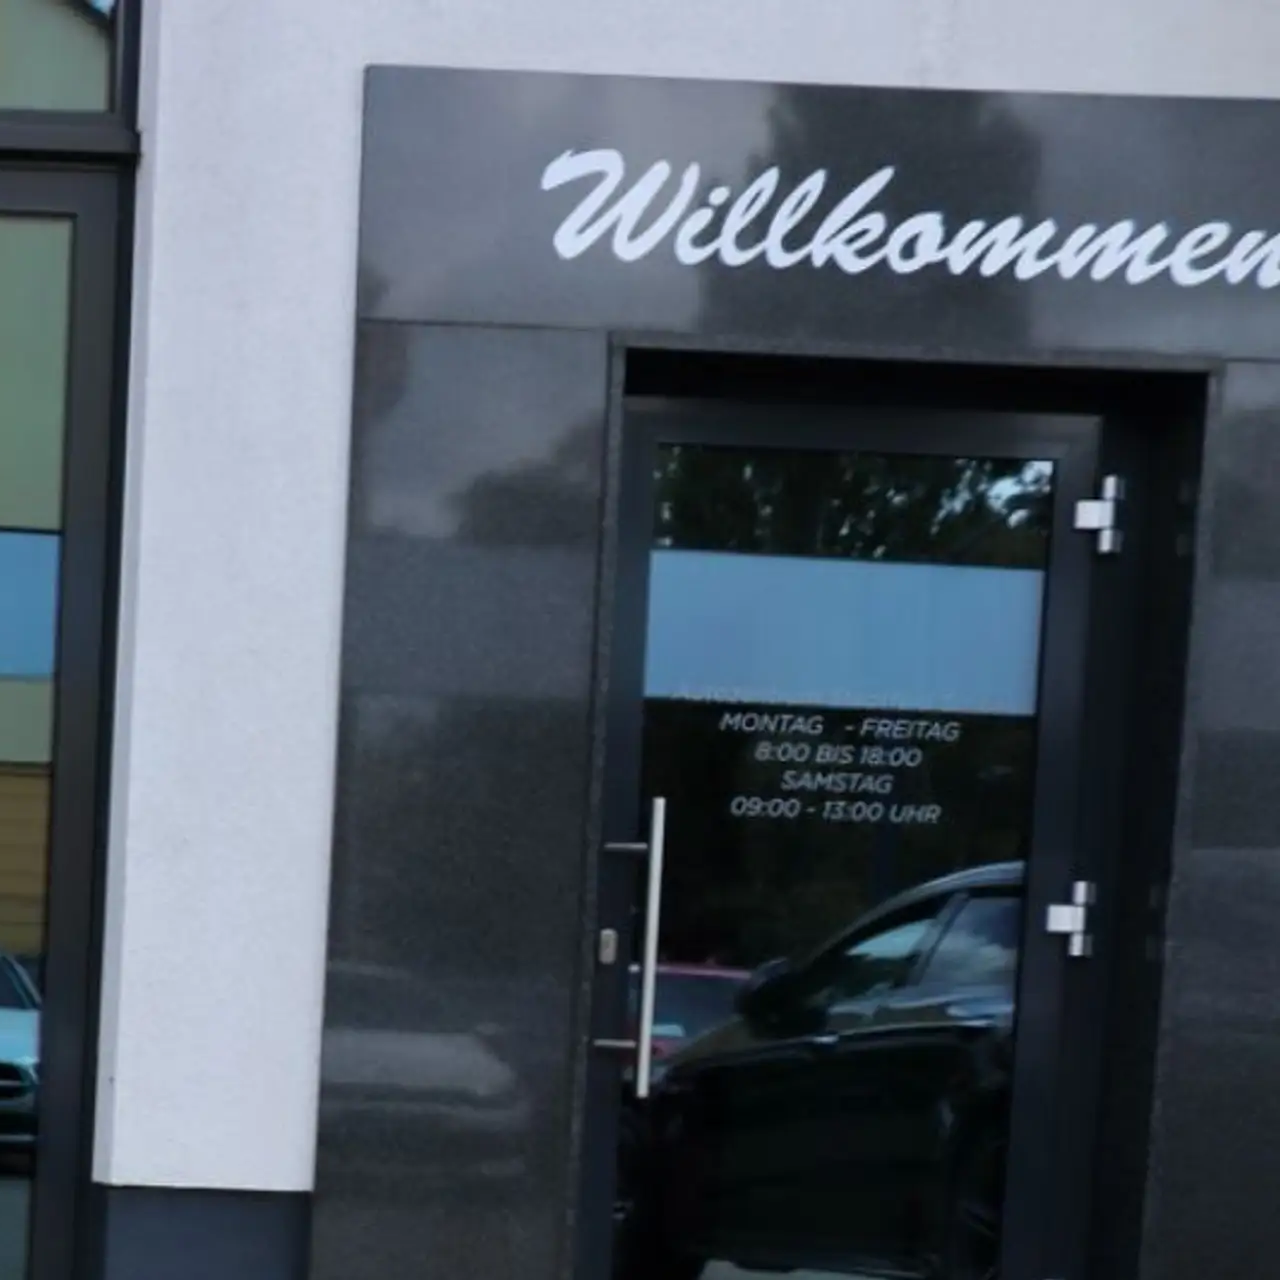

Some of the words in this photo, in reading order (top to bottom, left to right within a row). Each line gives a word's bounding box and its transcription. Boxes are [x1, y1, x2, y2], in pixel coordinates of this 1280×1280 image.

[541, 149, 1280, 289] Willkommen
[719, 712, 824, 735] MONTAG
[860, 717, 961, 742] FREITAG
[815, 744, 854, 764] BIS
[860, 747, 923, 767] 18:00
[780, 770, 894, 793] SAMSTAG
[730, 796, 800, 818] 09:00
[822, 801, 883, 821] 13:00
[889, 803, 942, 824] UHR
